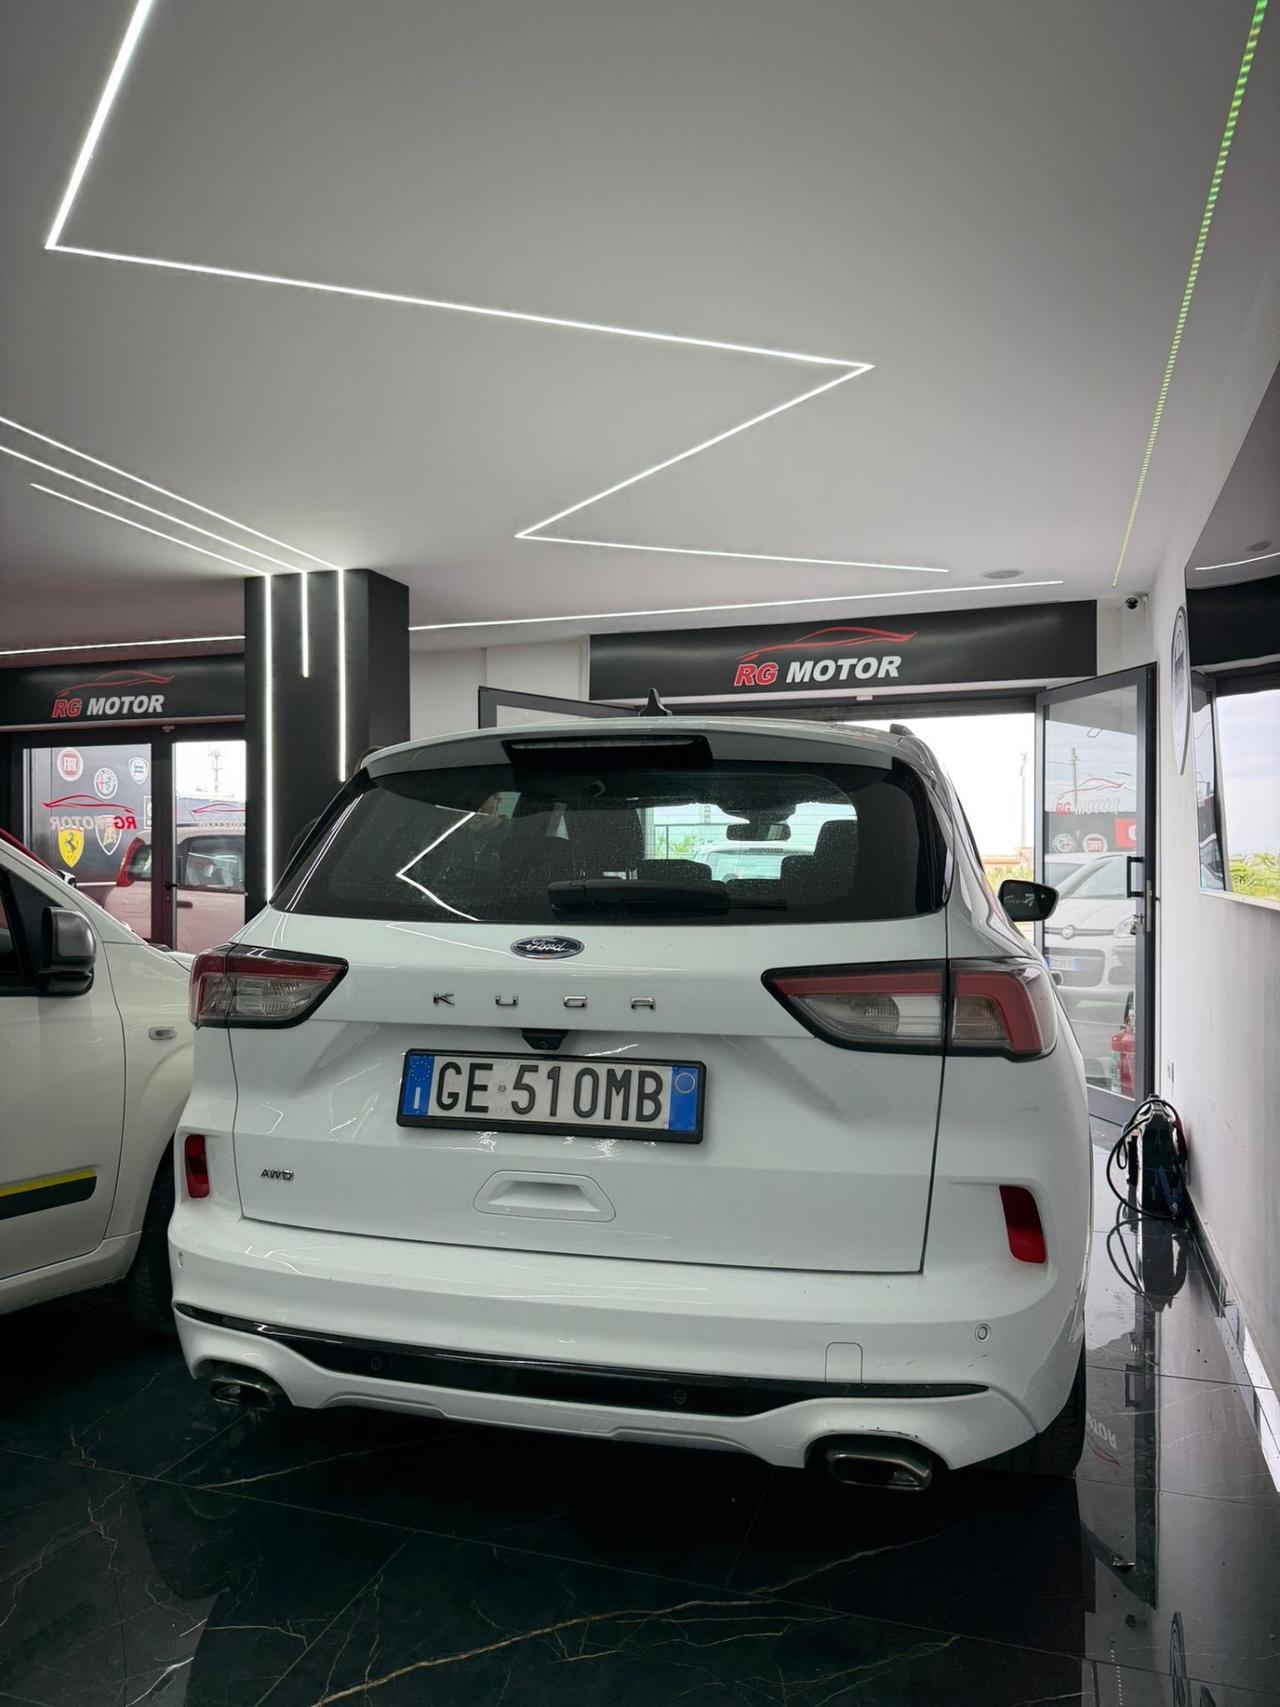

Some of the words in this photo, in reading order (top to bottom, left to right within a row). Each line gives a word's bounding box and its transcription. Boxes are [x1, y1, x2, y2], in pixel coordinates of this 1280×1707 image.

[733, 662, 779, 687] RG
[785, 656, 902, 684] MOTOR
[51, 698, 82, 718] RG
[86, 695, 165, 716] MOTOR
[432, 991, 656, 1010] KUGA
[435, 1061, 494, 1113] GE
[510, 1064, 663, 1122] 510MB
[260, 1168, 294, 1181] AWD
